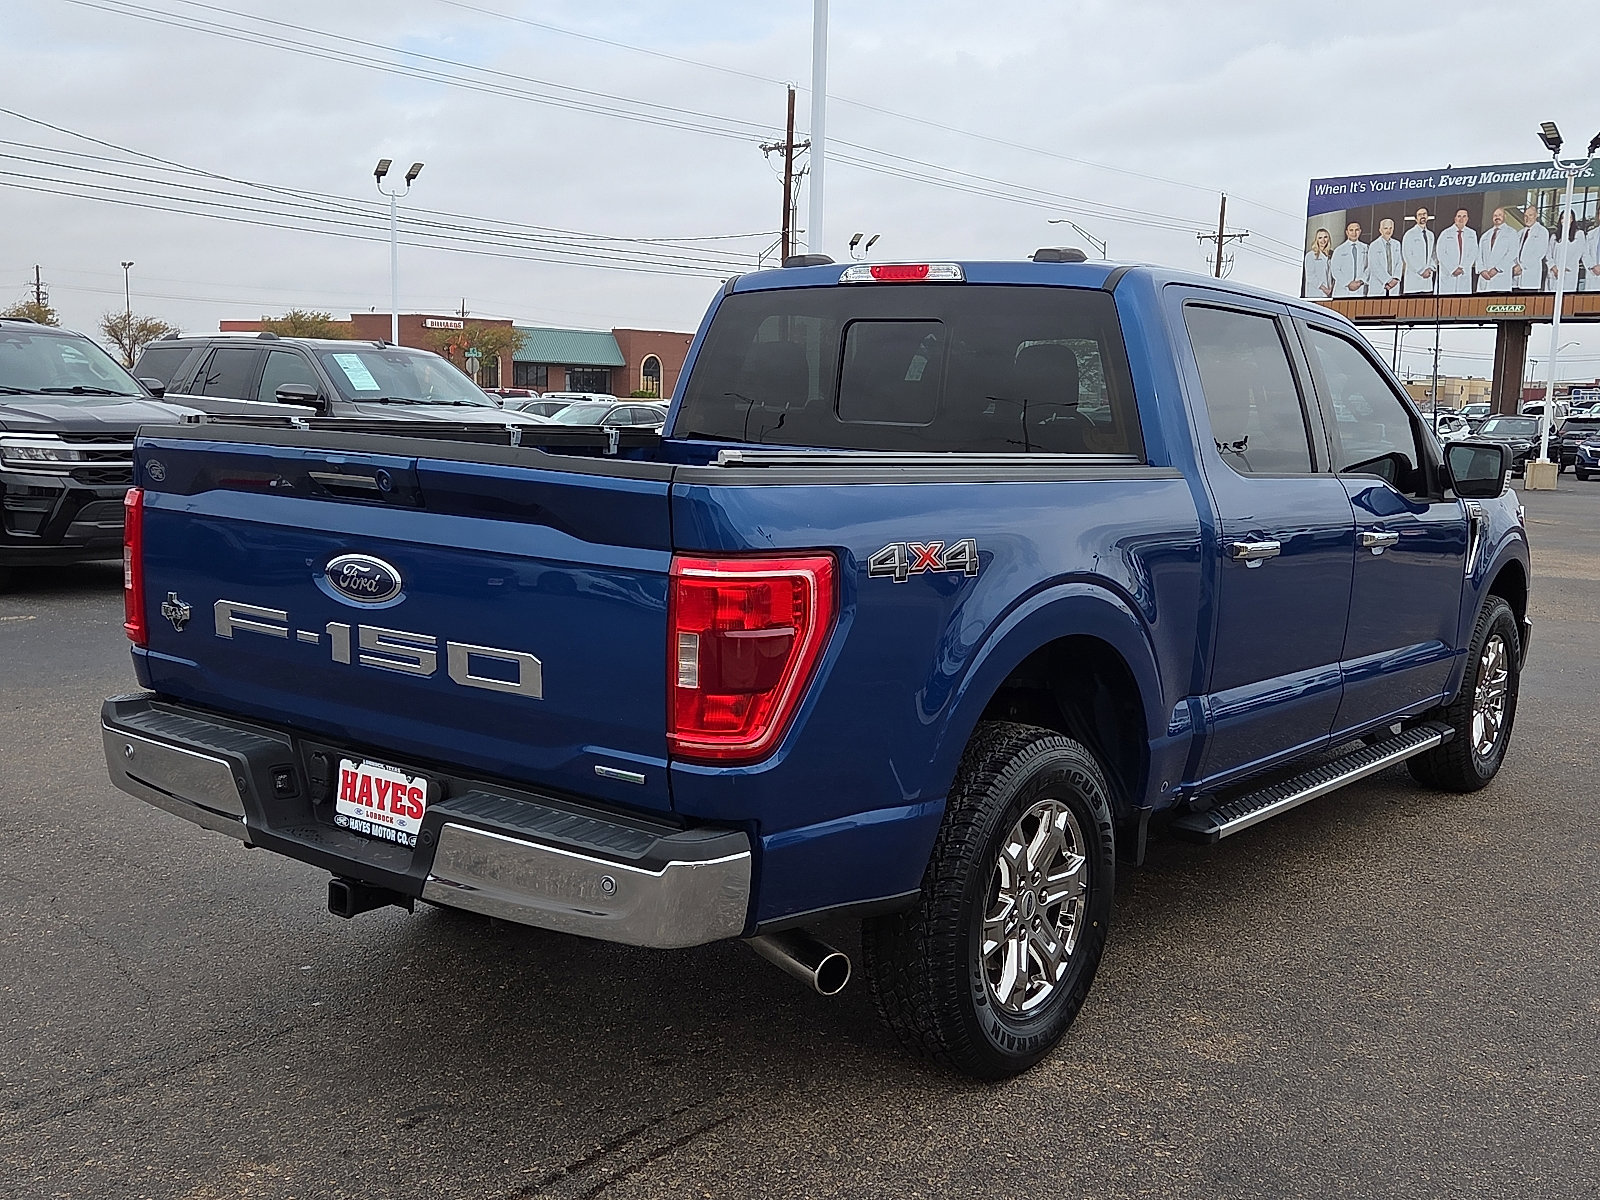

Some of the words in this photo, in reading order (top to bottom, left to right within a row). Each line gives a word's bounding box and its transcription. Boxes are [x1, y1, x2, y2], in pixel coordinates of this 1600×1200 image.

[1315, 184, 1347, 196] When
[1350, 181, 1366, 194] It's
[1370, 180, 1397, 192] Your
[1400, 176, 1436, 190] Heart,
[1438, 174, 1478, 187] Every
[1478, 171, 1536, 184] Moment
[339, 563, 380, 593] Ford
[214, 599, 543, 700] F-150
[340, 769, 423, 820] HAYES
[349, 818, 371, 834] HAYES
[371, 824, 396, 841] MOTOR
[366, 811, 394, 824] LUBBOCK
